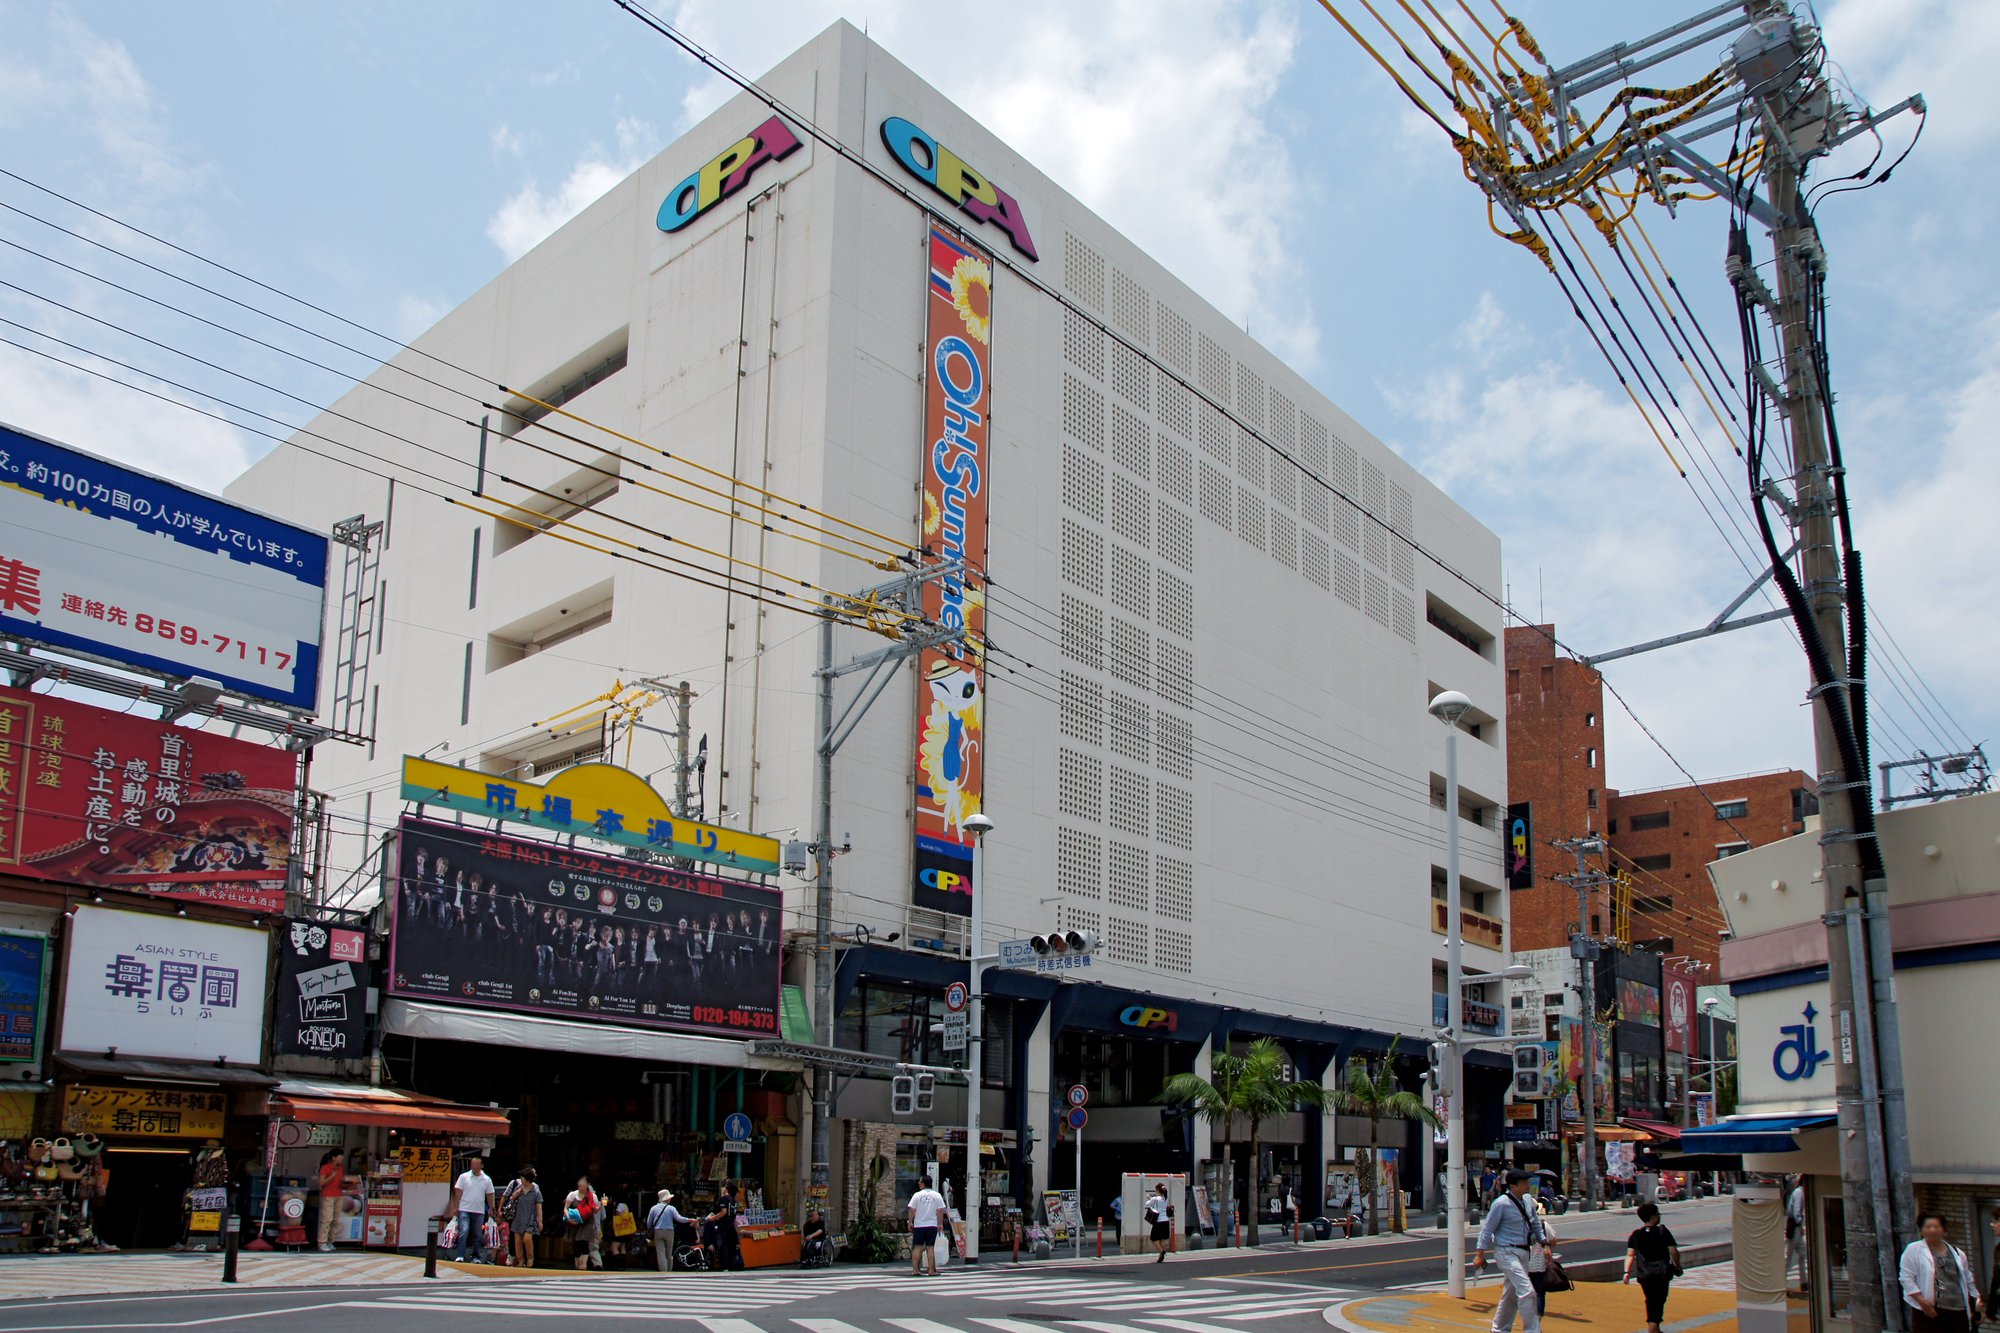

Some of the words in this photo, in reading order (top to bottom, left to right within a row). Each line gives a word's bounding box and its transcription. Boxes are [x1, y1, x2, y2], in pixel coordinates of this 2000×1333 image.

[656, 115, 803, 233] OPA
[880, 117, 1039, 263] OPA
[61, 592, 128, 626] 連絡先
[134, 613, 293, 671] 859-7117
[36, 714, 68, 789] 琉球泡盛
[154, 732, 185, 824] 首里城の
[85, 746, 117, 855] お土産に。
[120, 757, 149, 827] 感動を
[485, 783, 718, 854] 市場本通り
[480, 839, 512, 860] 大阪
[1512, 818, 1527, 875] OPA
[919, 868, 973, 896] OPA
[136, 944, 175, 955] ASIAN
[179, 949, 219, 962] STYLE
[1037, 955, 1091, 972] 時差式信号機
[693, 1005, 775, 1029] 0120-194-373
[1119, 1006, 1178, 1031] OPA
[400, 1147, 450, 1161] 骨董品
[400, 1161, 450, 1173] アンティーク
